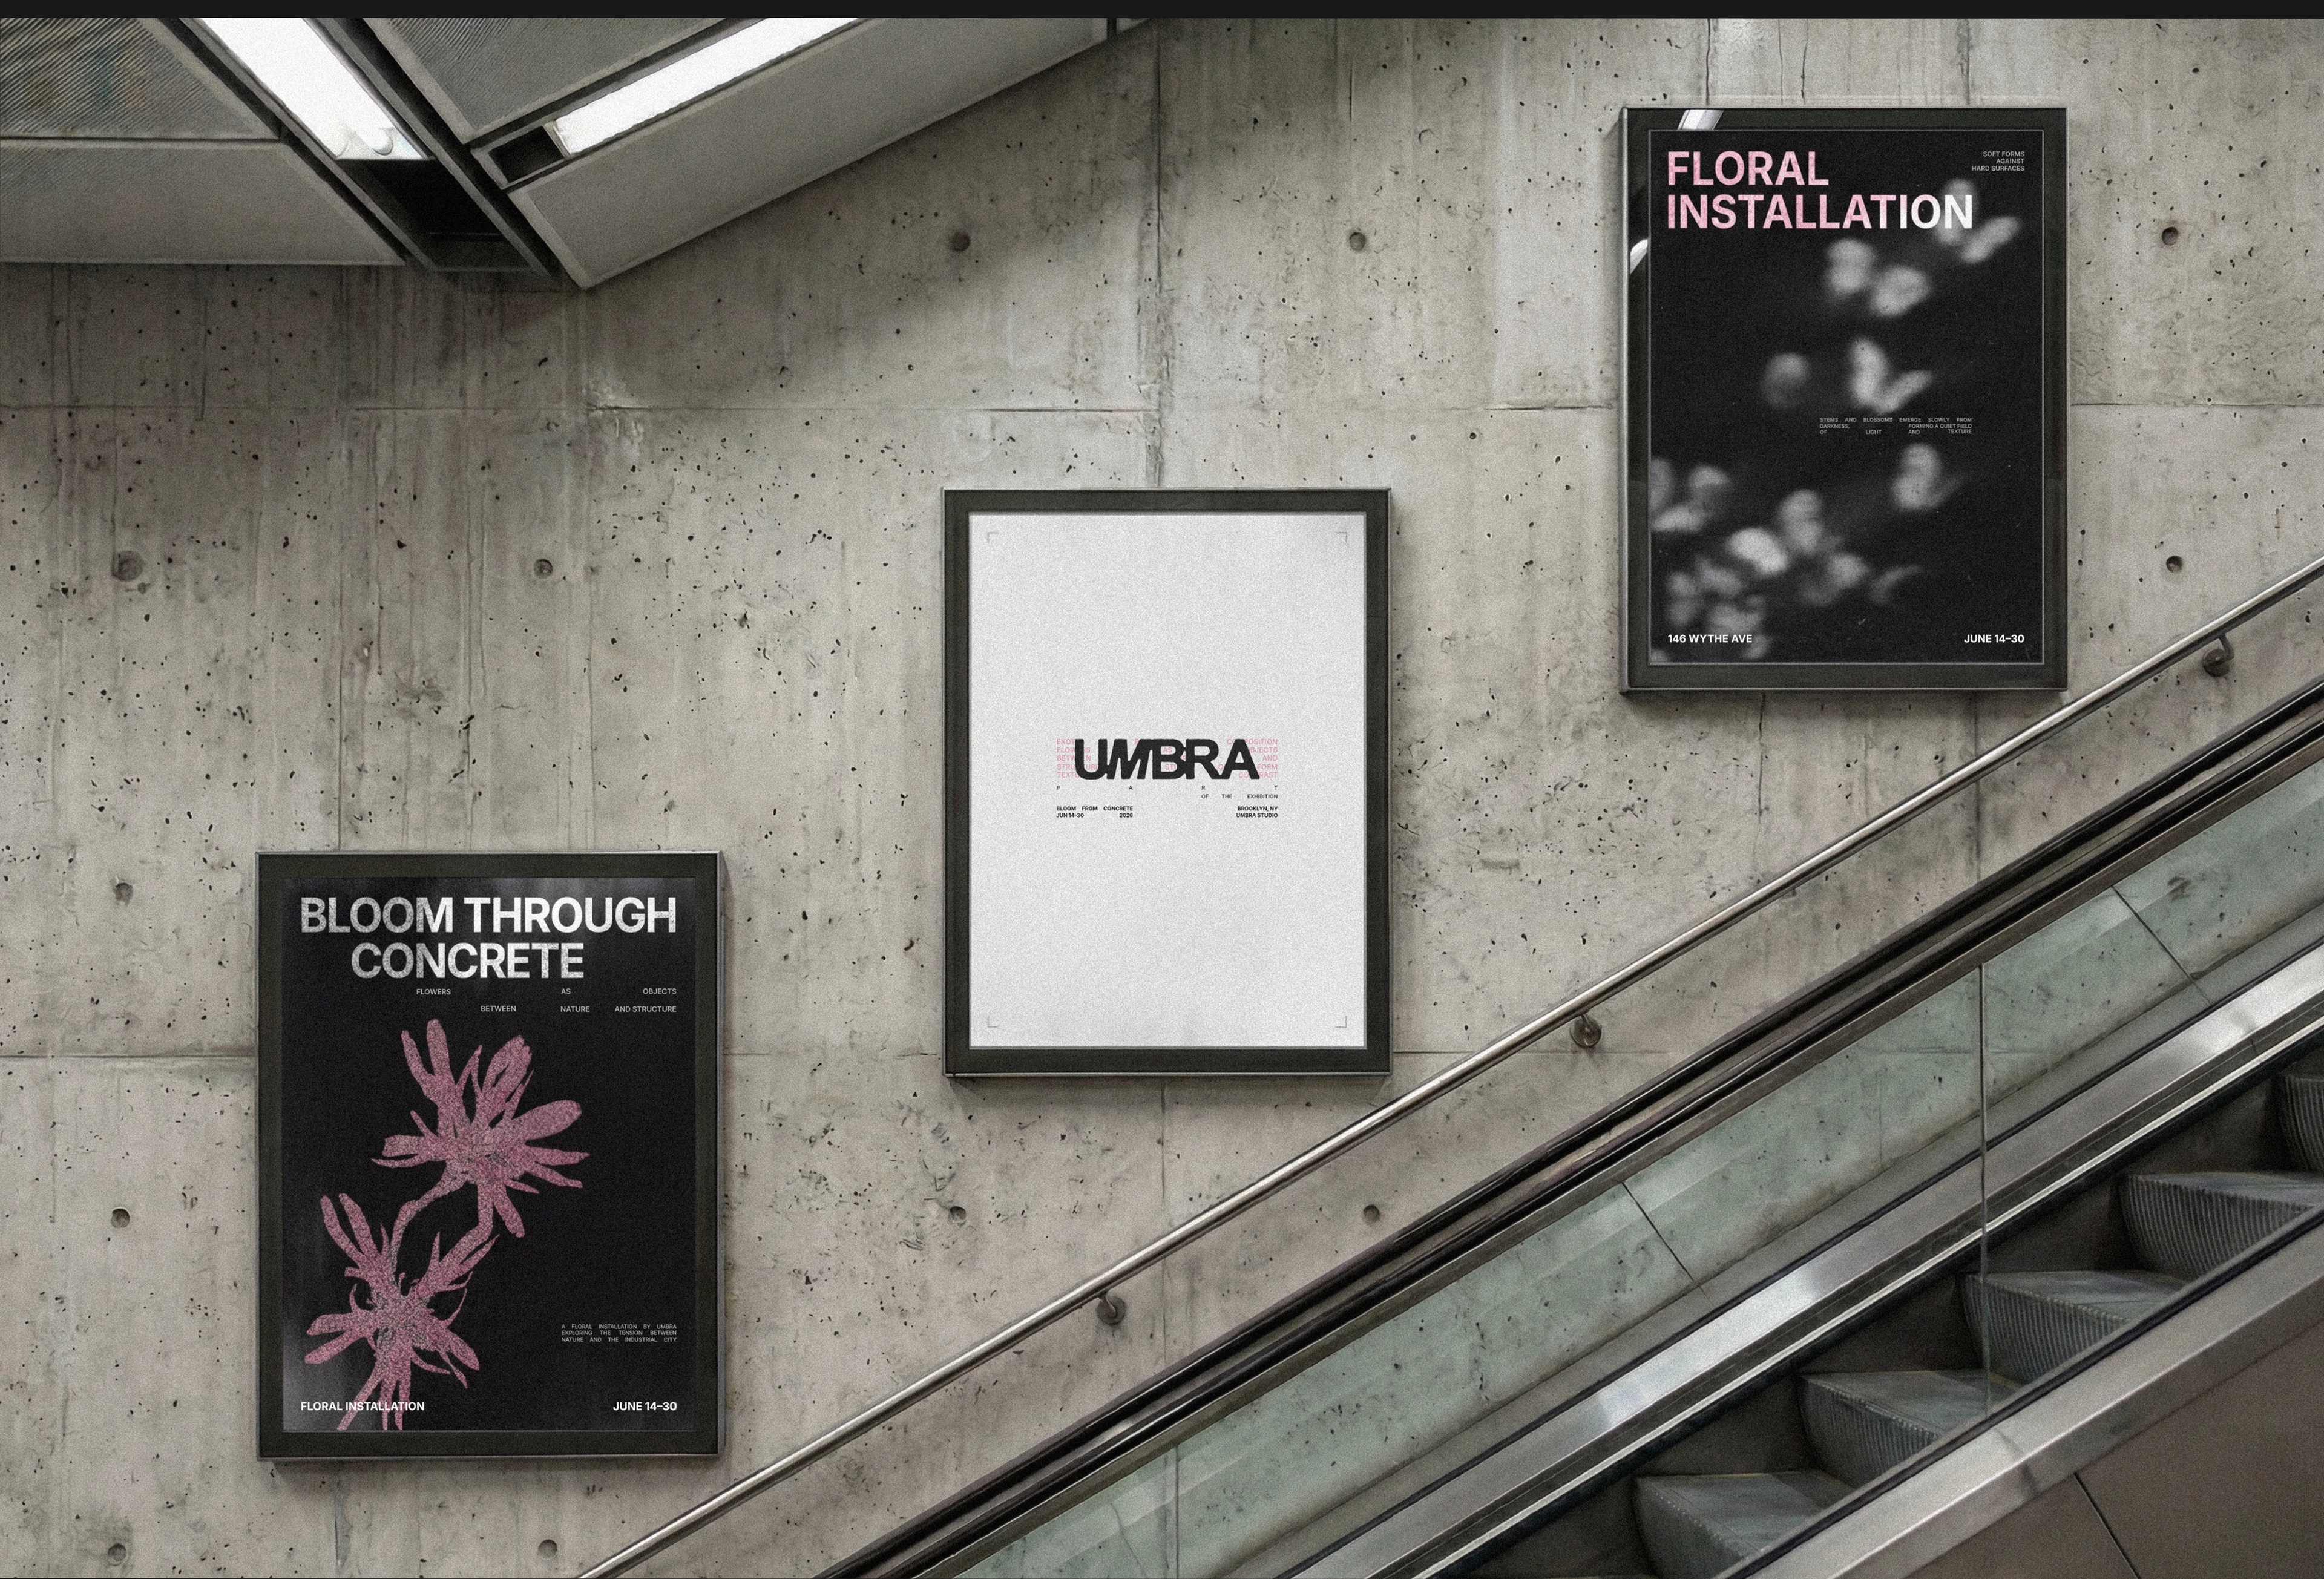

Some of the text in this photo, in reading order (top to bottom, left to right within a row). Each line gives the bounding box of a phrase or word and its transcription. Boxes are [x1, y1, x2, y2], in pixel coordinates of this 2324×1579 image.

[1667, 151, 1829, 185] FLORAL
[1667, 194, 1972, 229] INSTALLATION
[1667, 634, 1752, 643] 146 WYTHE AVE
[1964, 634, 1991, 643] JUNE
[1075, 739, 1260, 780] UMBRA
[301, 896, 677, 933] BLOOM THROUGH
[351, 942, 584, 979] CONCRETE
[301, 1402, 425, 1411] FLORAL INSTALLATION
[612, 1402, 642, 1411] JUNE
